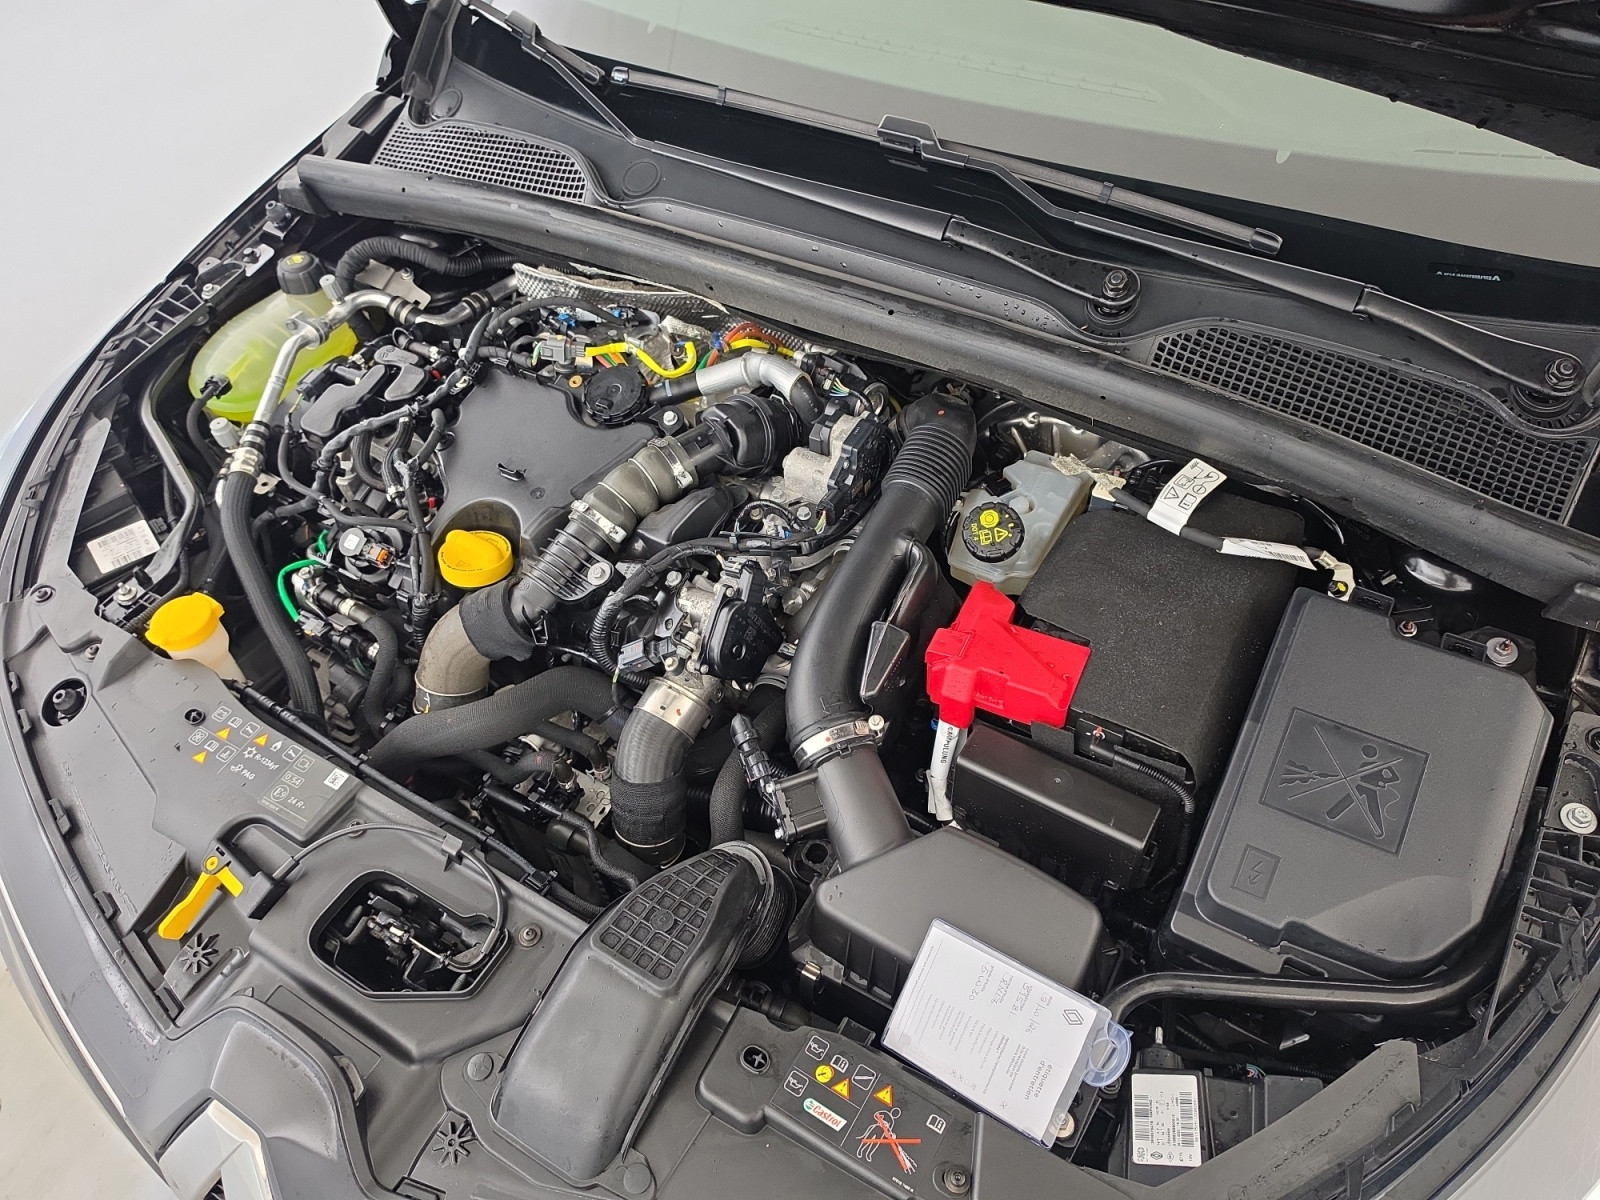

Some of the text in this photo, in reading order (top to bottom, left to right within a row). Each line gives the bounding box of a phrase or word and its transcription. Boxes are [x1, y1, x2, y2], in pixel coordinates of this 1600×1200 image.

[254, 753, 280, 770] R-1234yf
[241, 769, 256, 780] PAG
[288, 796, 298, 804] 24
[1025, 1060, 1046, 1100] d'entretien
[1034, 1064, 1052, 1098] étiquette
[812, 1105, 842, 1128] Castrol
